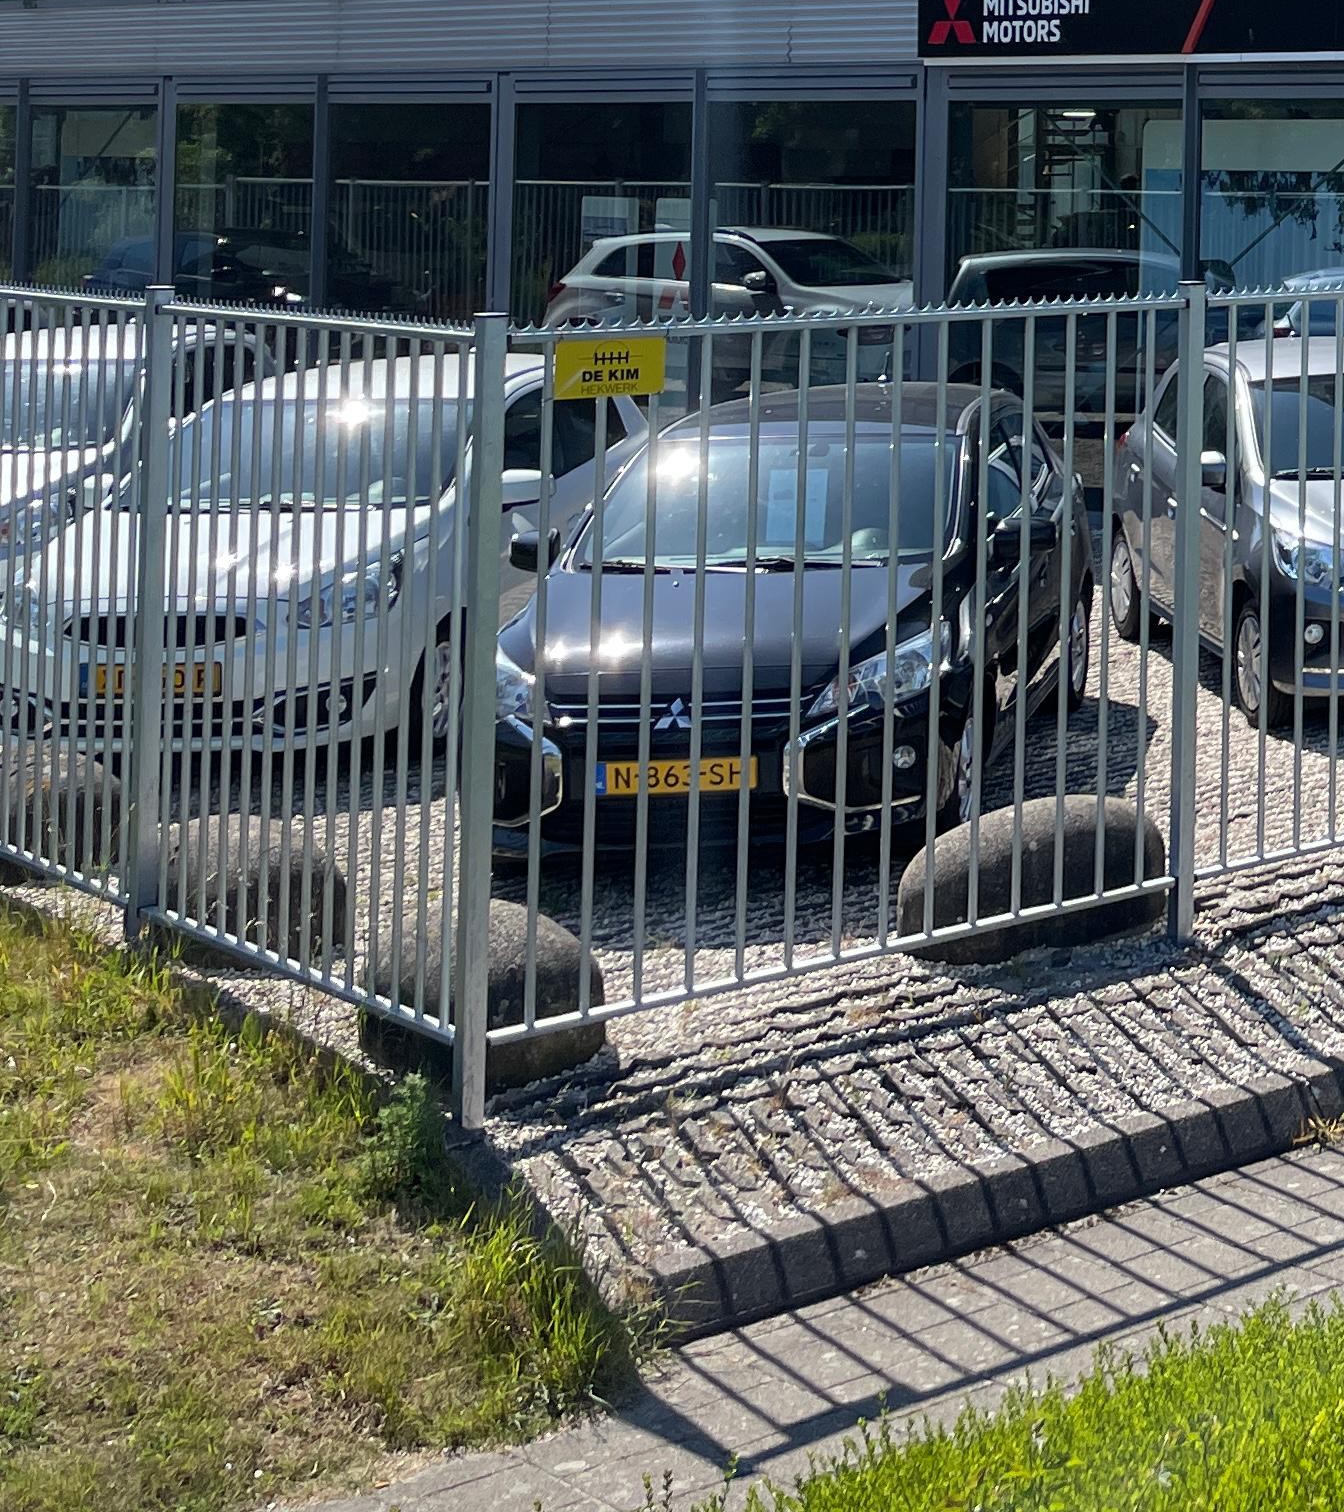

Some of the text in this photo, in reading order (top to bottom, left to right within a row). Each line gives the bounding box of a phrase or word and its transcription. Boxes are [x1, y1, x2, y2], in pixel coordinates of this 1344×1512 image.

[982, 19, 1061, 43] MOTORS
[582, 368, 640, 383] DE KIM
[580, 382, 640, 395] HEKWERK
